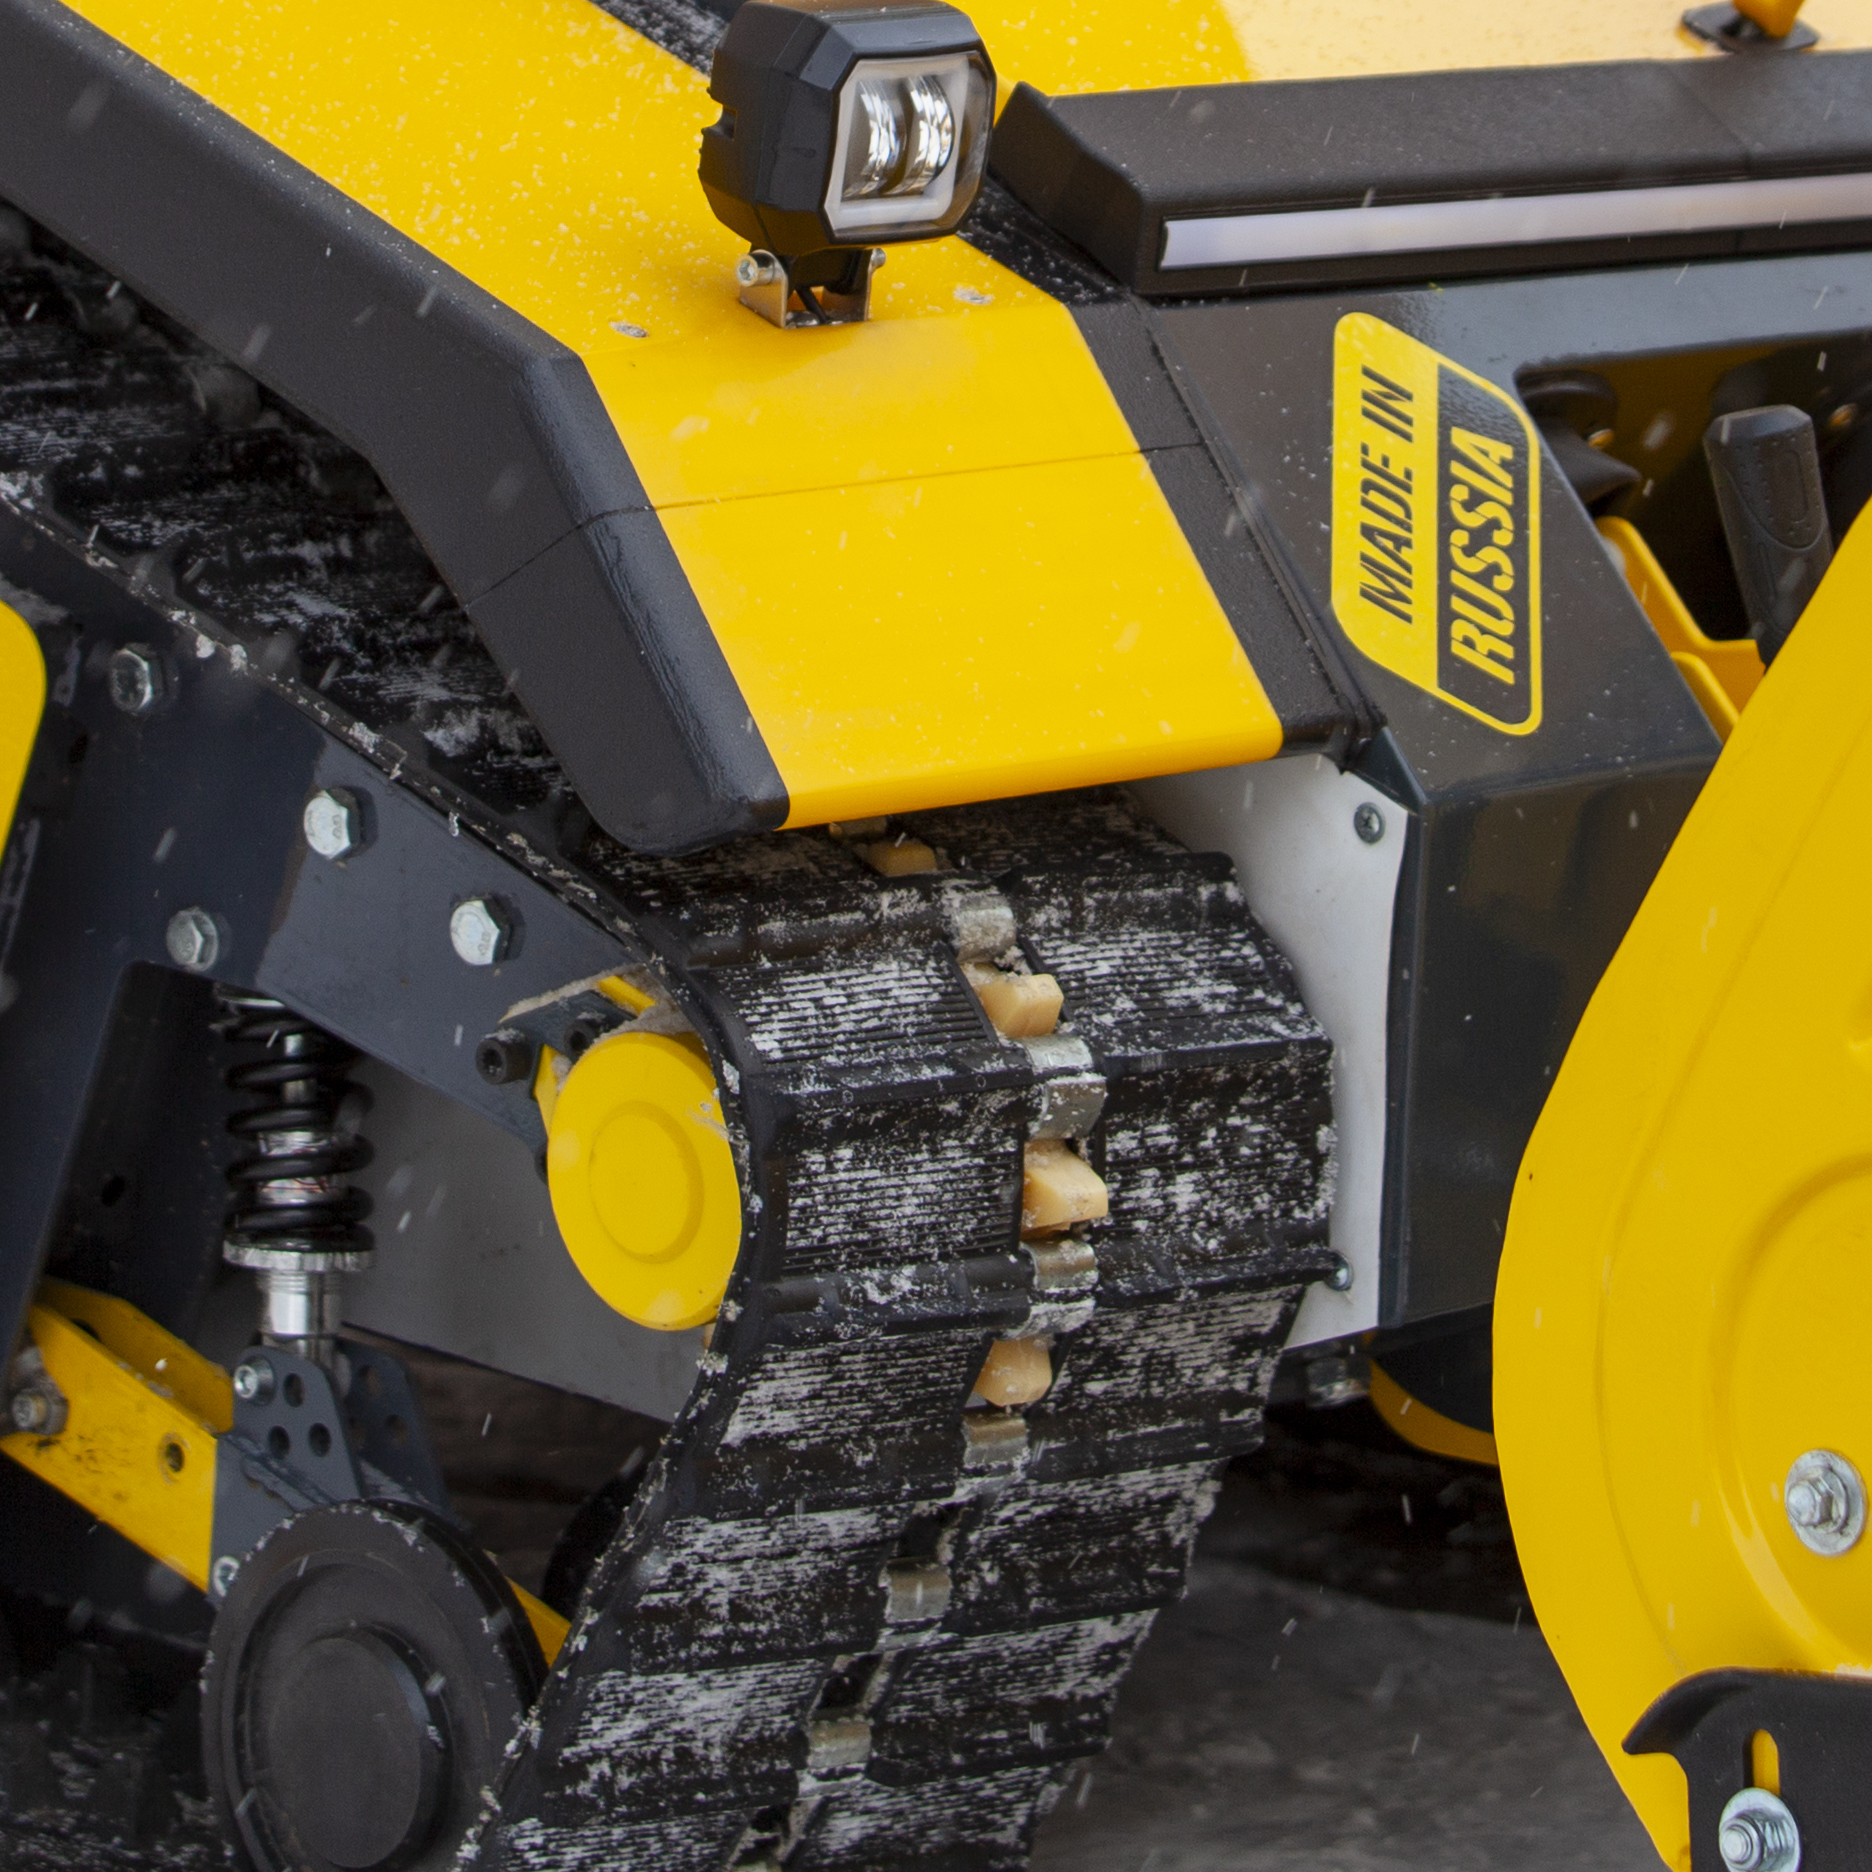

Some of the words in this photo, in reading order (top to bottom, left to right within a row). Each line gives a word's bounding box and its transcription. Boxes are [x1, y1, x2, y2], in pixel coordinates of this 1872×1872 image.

[1361, 366, 1414, 443] IN
[1359, 442, 1414, 625] MADE
[1450, 426, 1515, 685] RUSSIA
